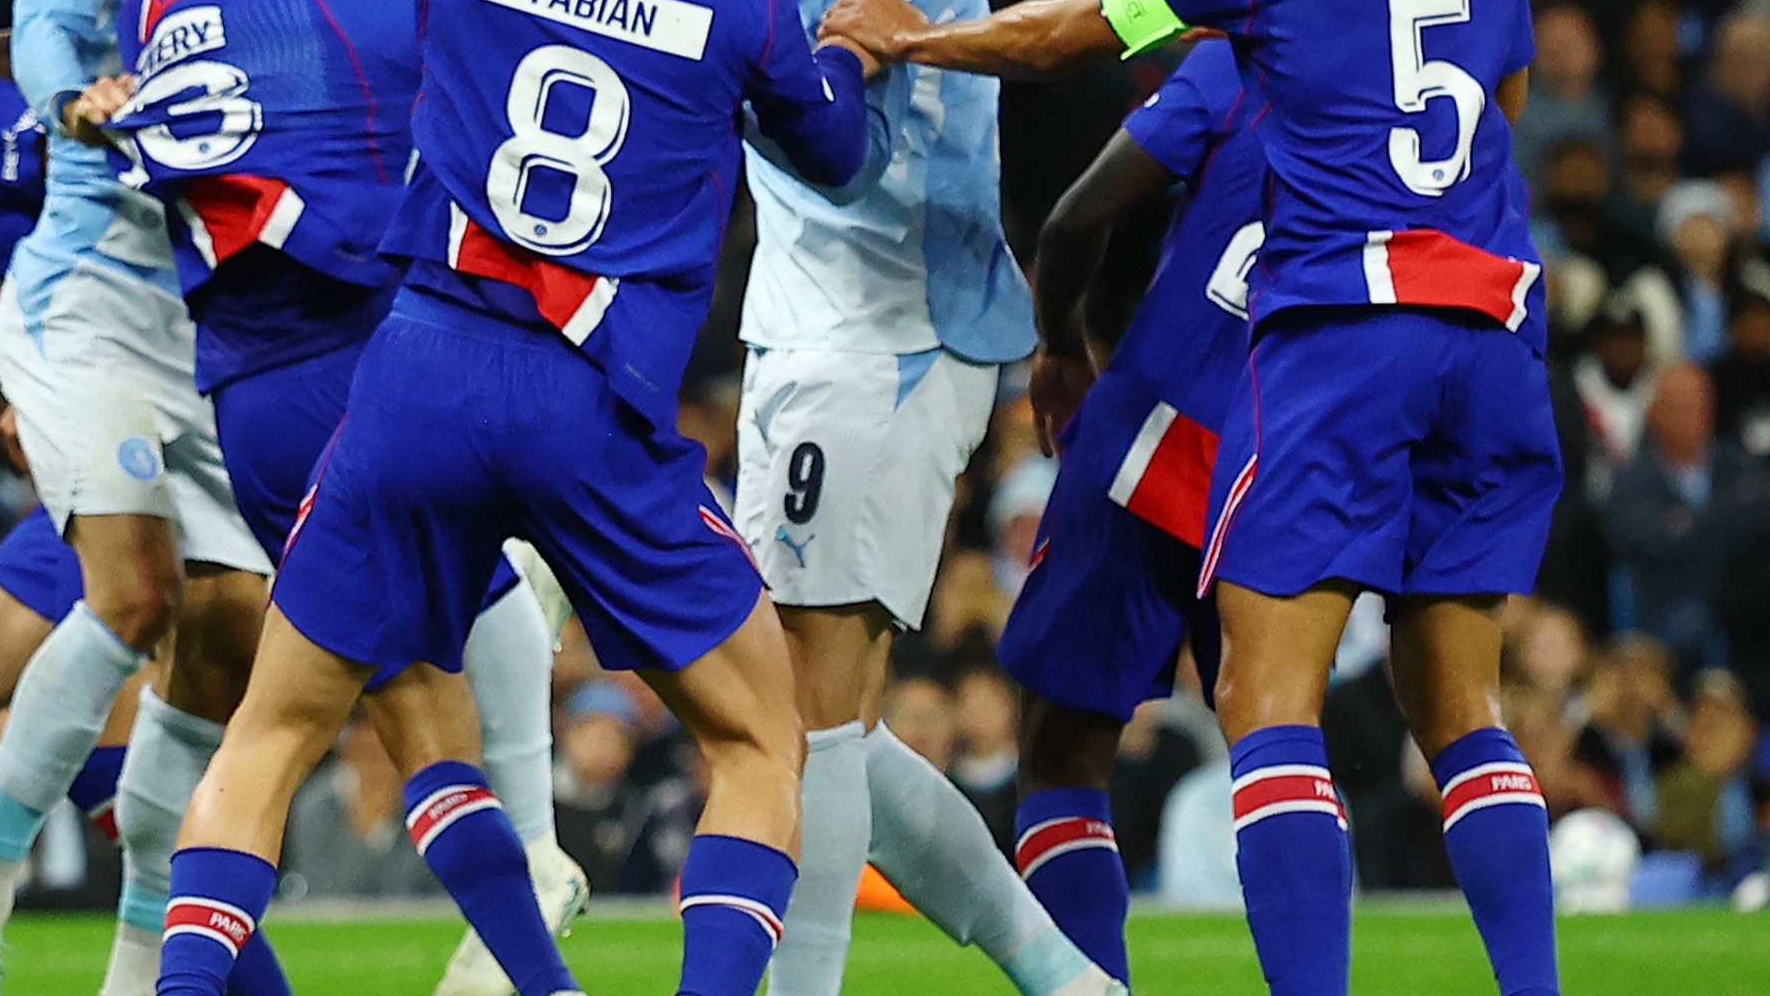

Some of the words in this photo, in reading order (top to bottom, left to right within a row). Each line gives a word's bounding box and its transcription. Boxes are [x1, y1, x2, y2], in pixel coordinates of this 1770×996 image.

[485, 43, 631, 258] 8
[784, 441, 825, 525] 9
[1491, 774, 1533, 791] PARIS
[209, 911, 248, 942] PARIS
